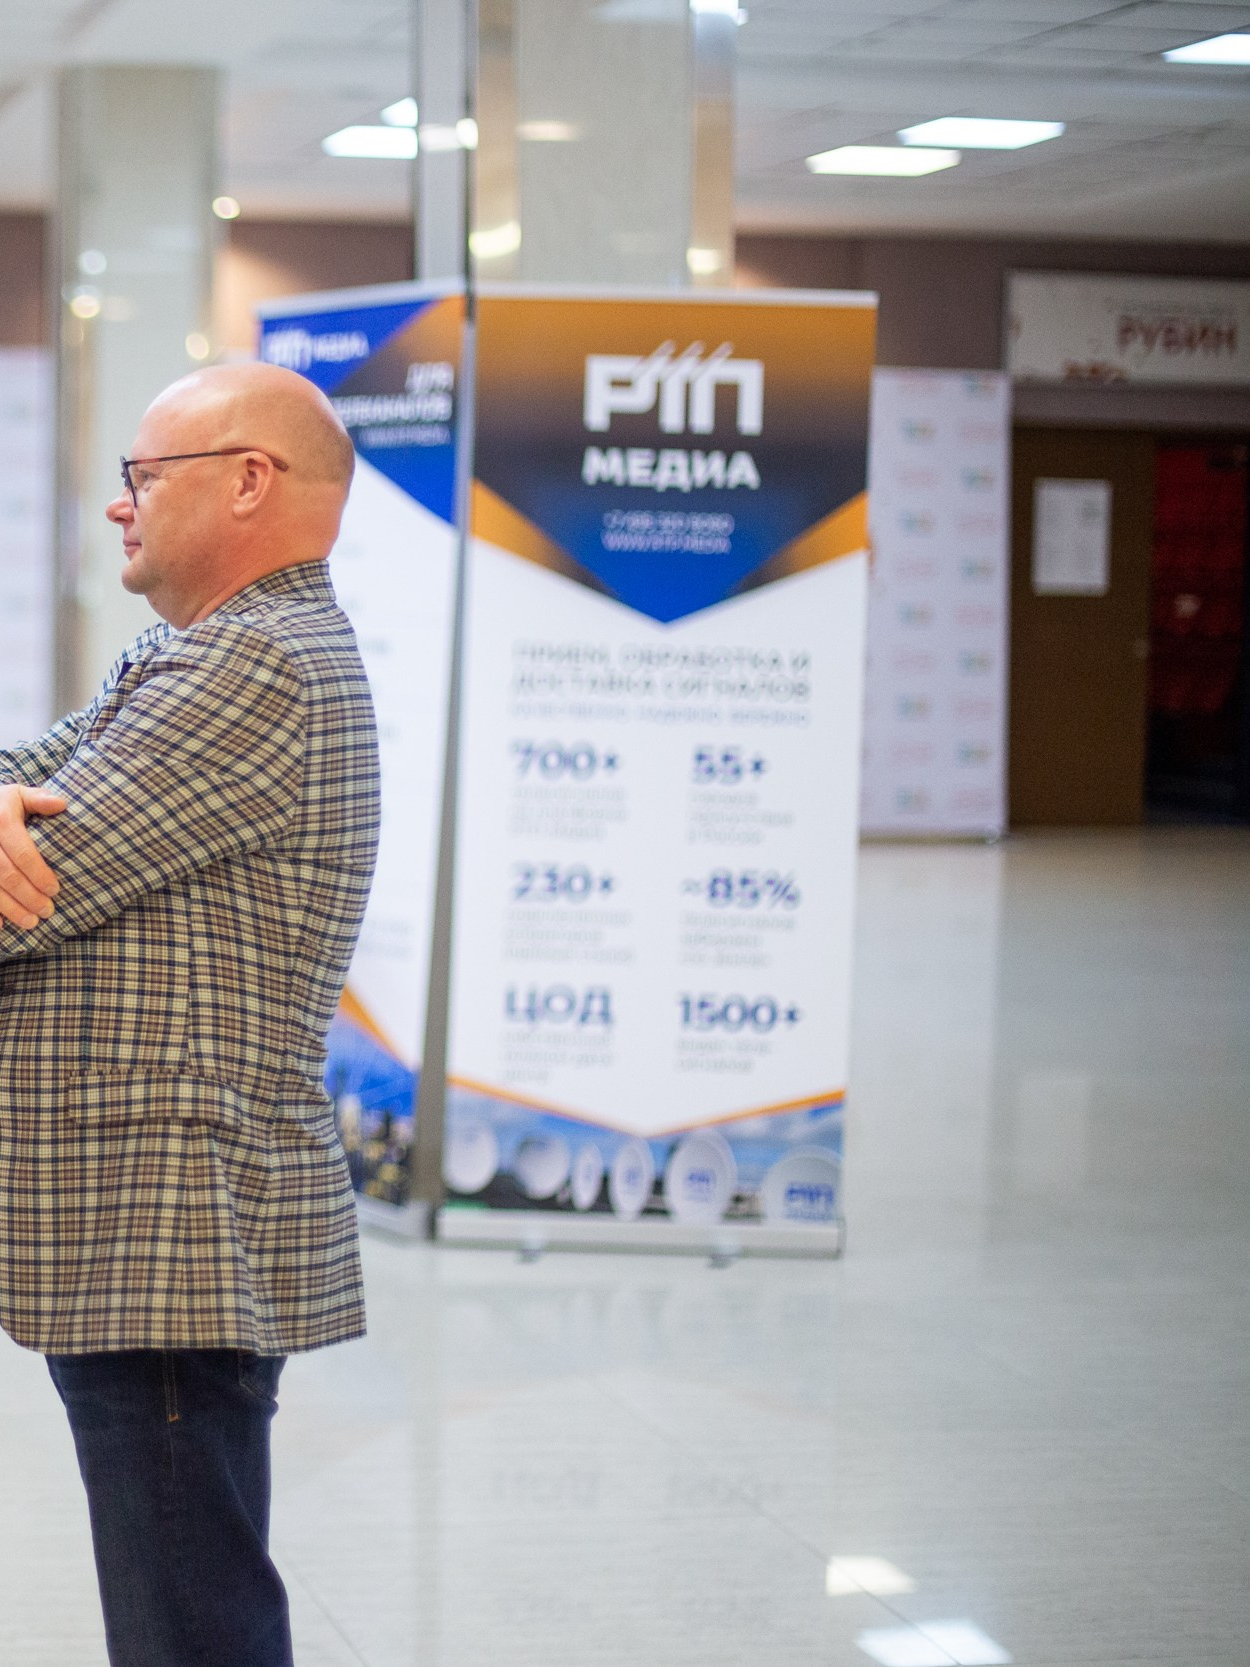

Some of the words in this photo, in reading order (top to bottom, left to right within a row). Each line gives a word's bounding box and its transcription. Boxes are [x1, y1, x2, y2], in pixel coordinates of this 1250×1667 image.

[1117, 315, 1238, 356] РУБИН
[582, 446, 761, 493] МЕДИА
[510, 739, 621, 781] 700+
[693, 743, 768, 785] 55+
[511, 861, 617, 904] 230+
[505, 984, 614, 1031] ЦОД
[679, 992, 802, 1034] 1500+
